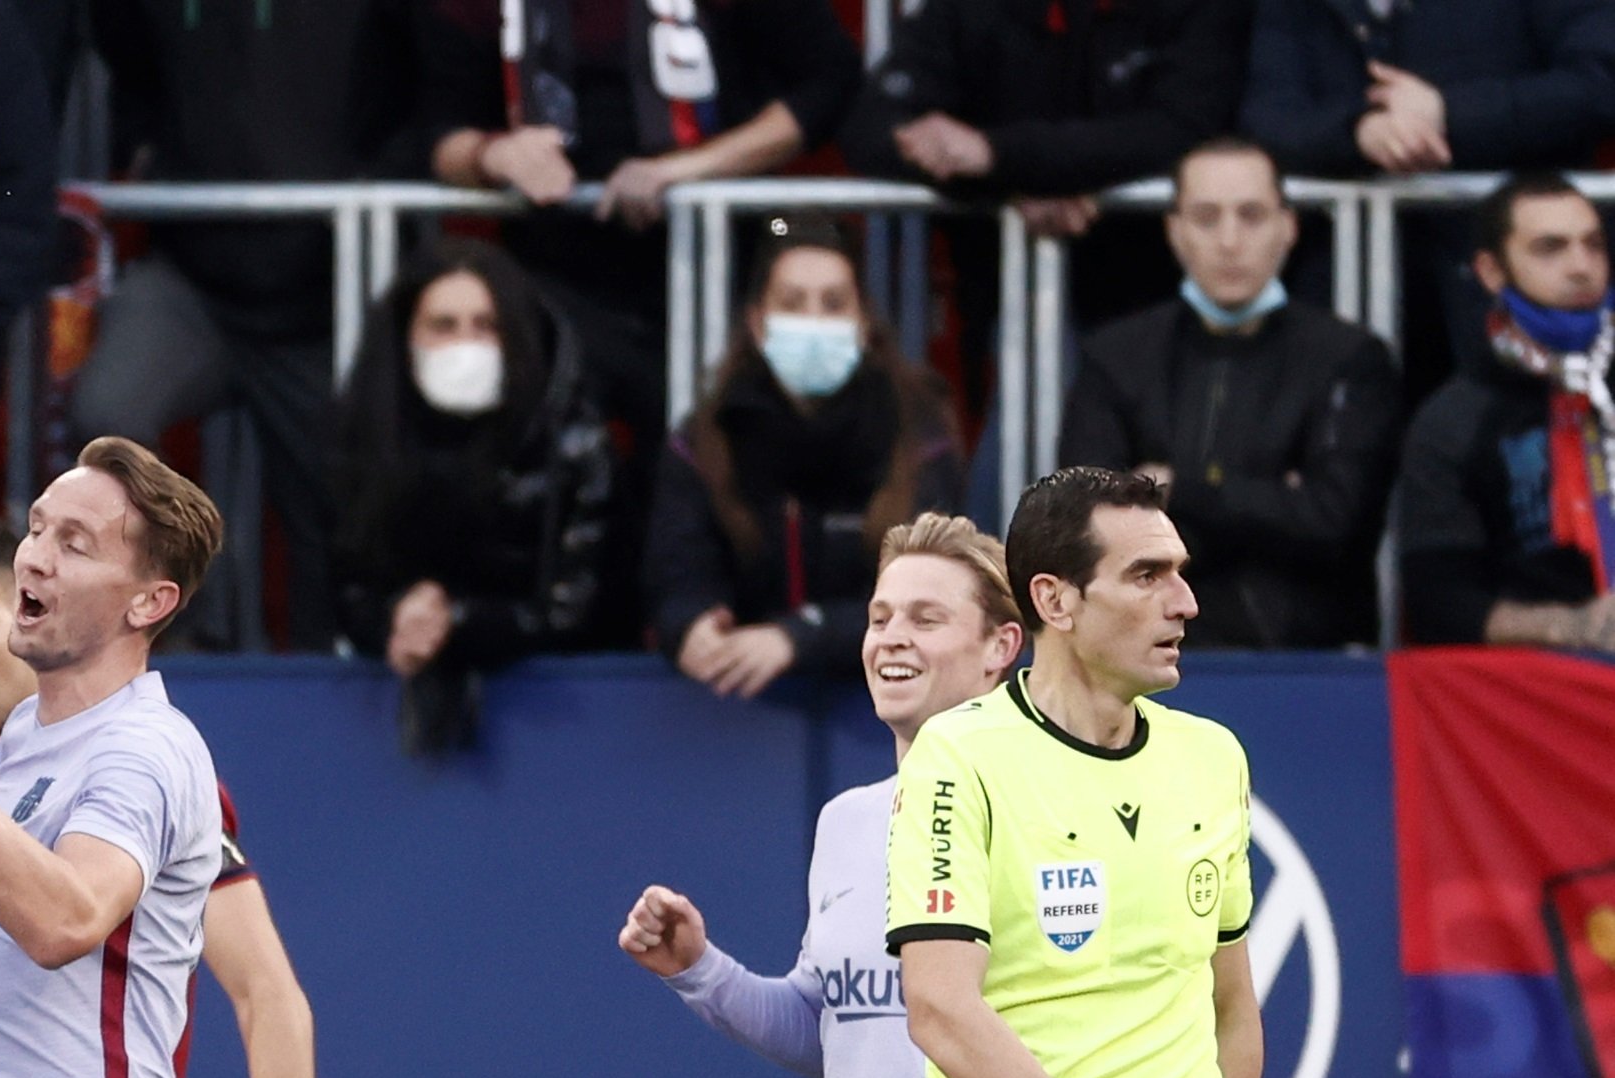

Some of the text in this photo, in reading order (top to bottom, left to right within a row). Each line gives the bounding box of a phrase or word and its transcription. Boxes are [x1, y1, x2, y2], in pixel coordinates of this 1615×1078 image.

[1041, 867, 1098, 890] FIFA
[1043, 903, 1099, 917] REFEREE
[1057, 933, 1083, 945] 2021
